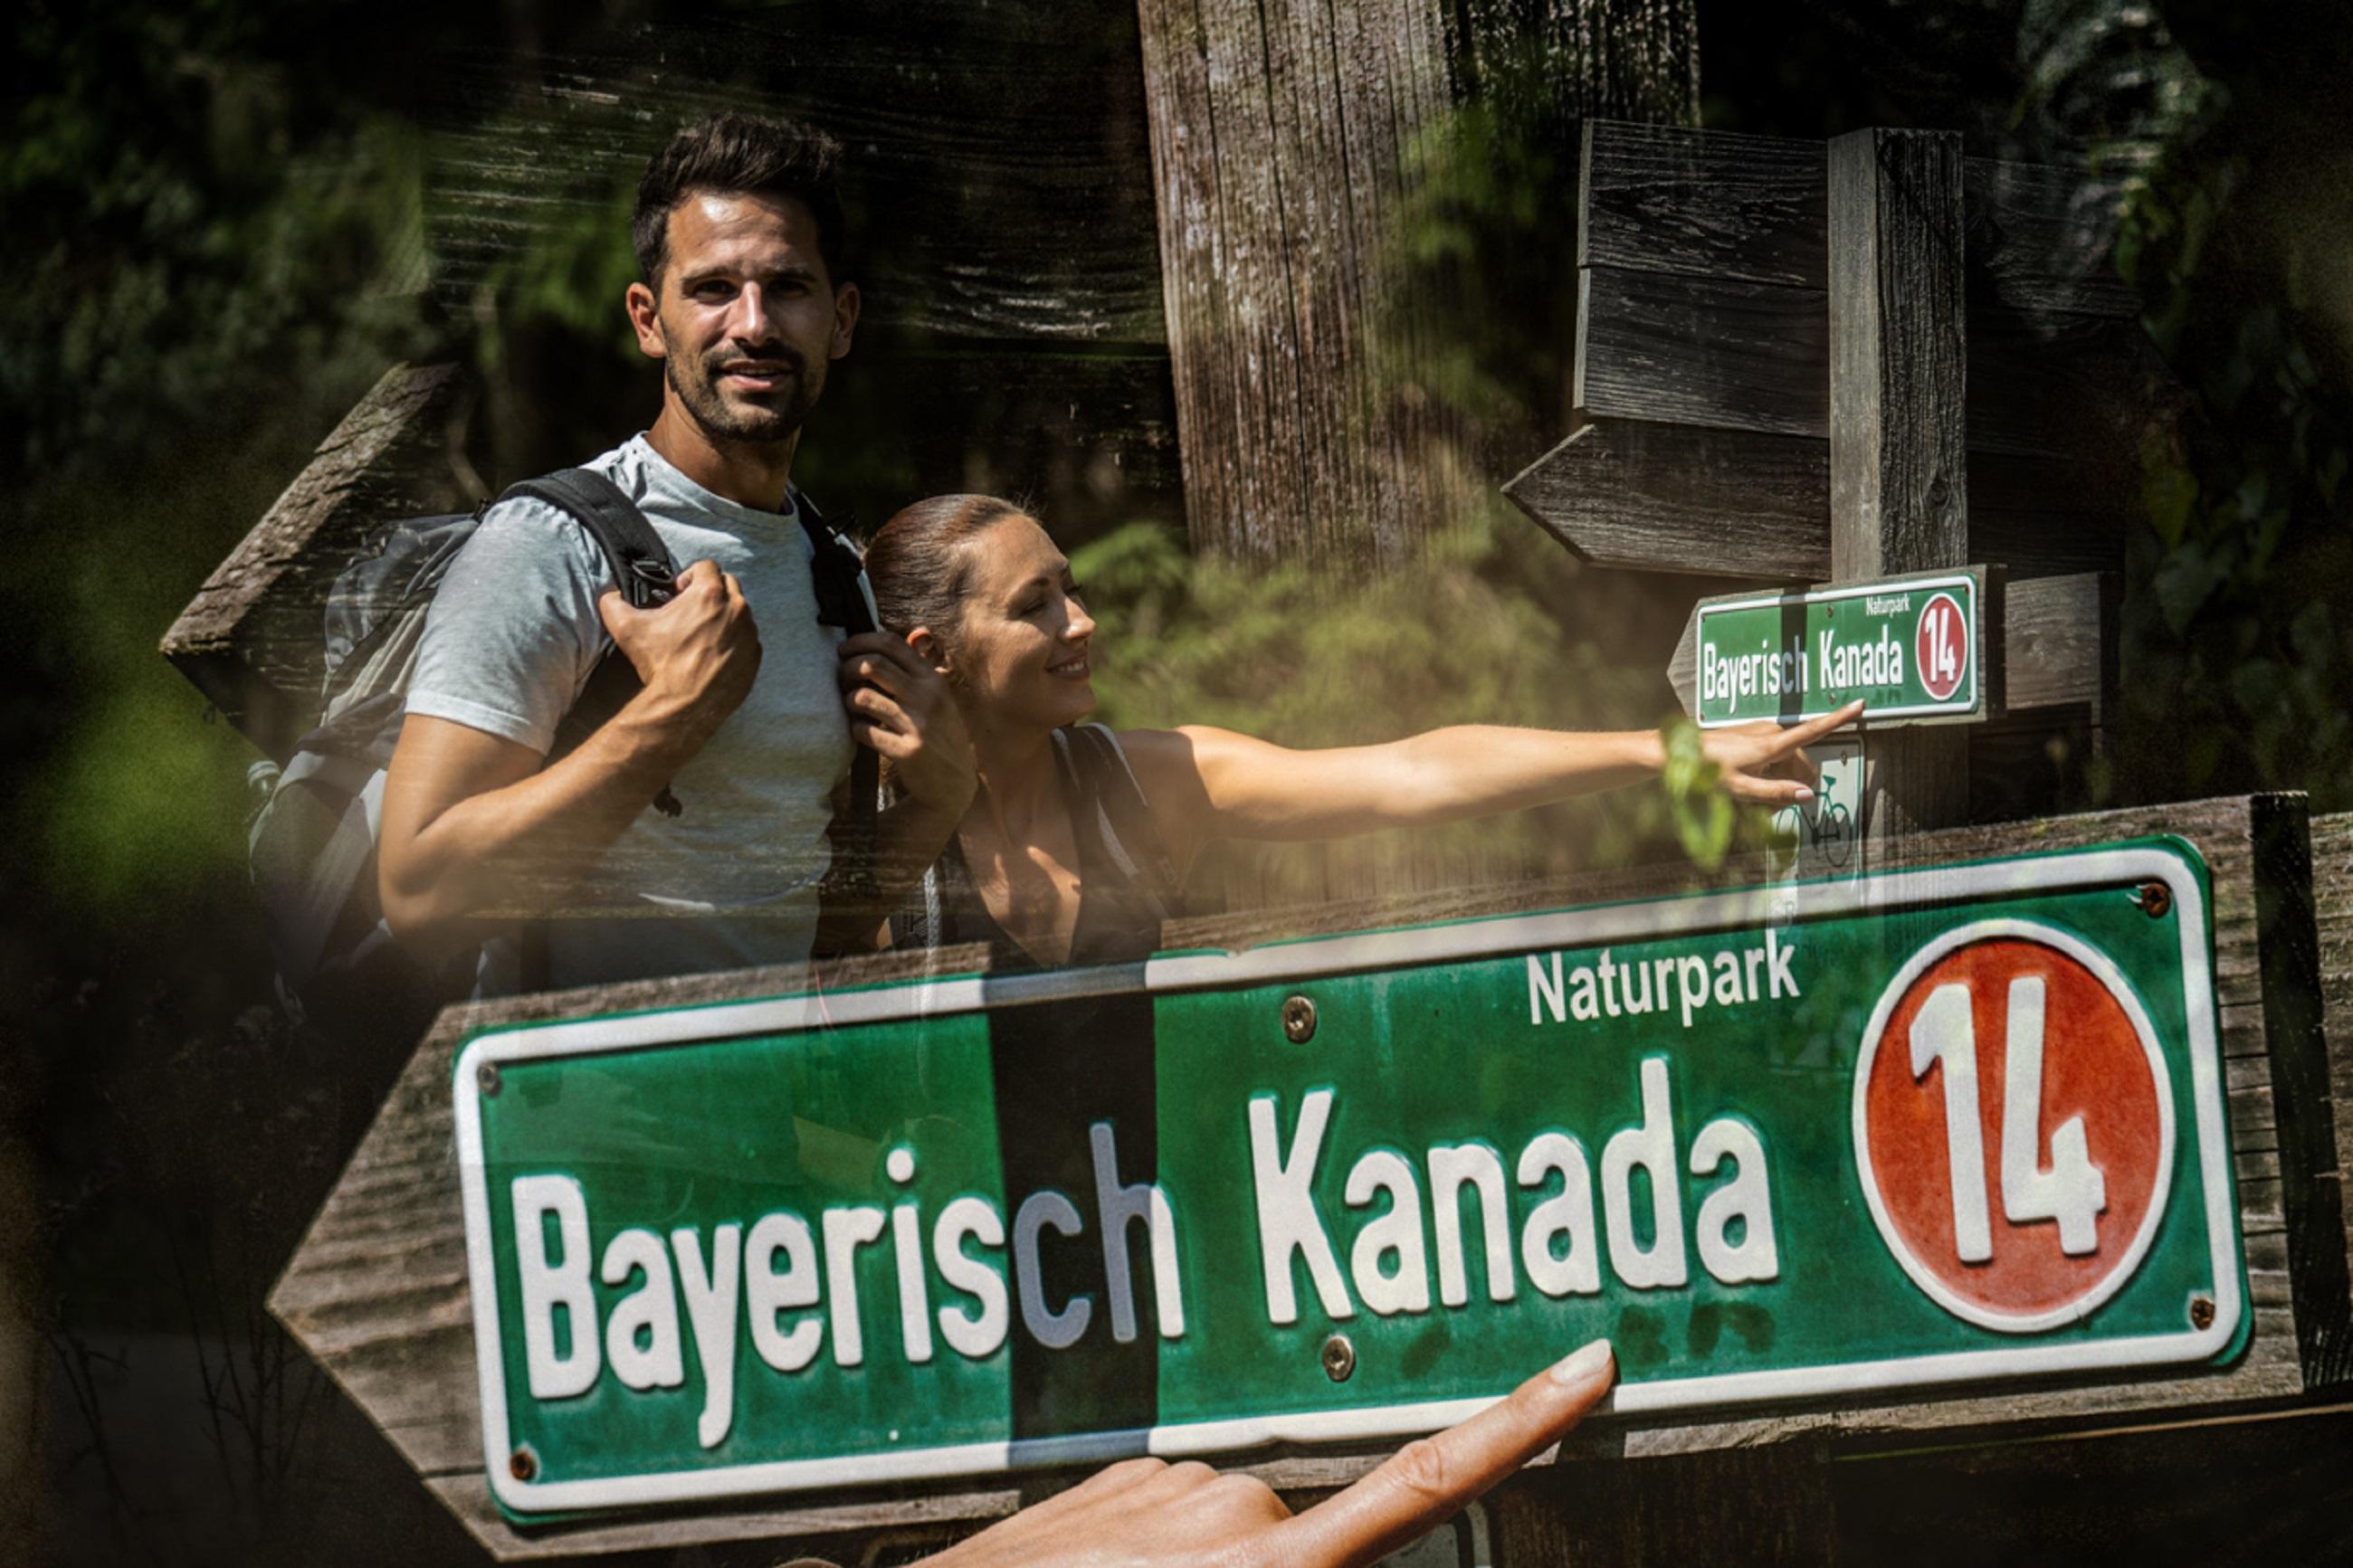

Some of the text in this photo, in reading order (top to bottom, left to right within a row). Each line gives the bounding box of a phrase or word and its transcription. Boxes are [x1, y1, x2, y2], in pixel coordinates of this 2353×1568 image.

[1866, 593, 1910, 618] Naturpark
[1924, 607, 1957, 683] 14
[1703, 623, 1903, 715] Bayerisch Kanada
[1527, 927, 1800, 1027] Naturpark
[1909, 974, 2106, 1263] 14
[510, 1055, 1779, 1449] Bayerisch Kanada
